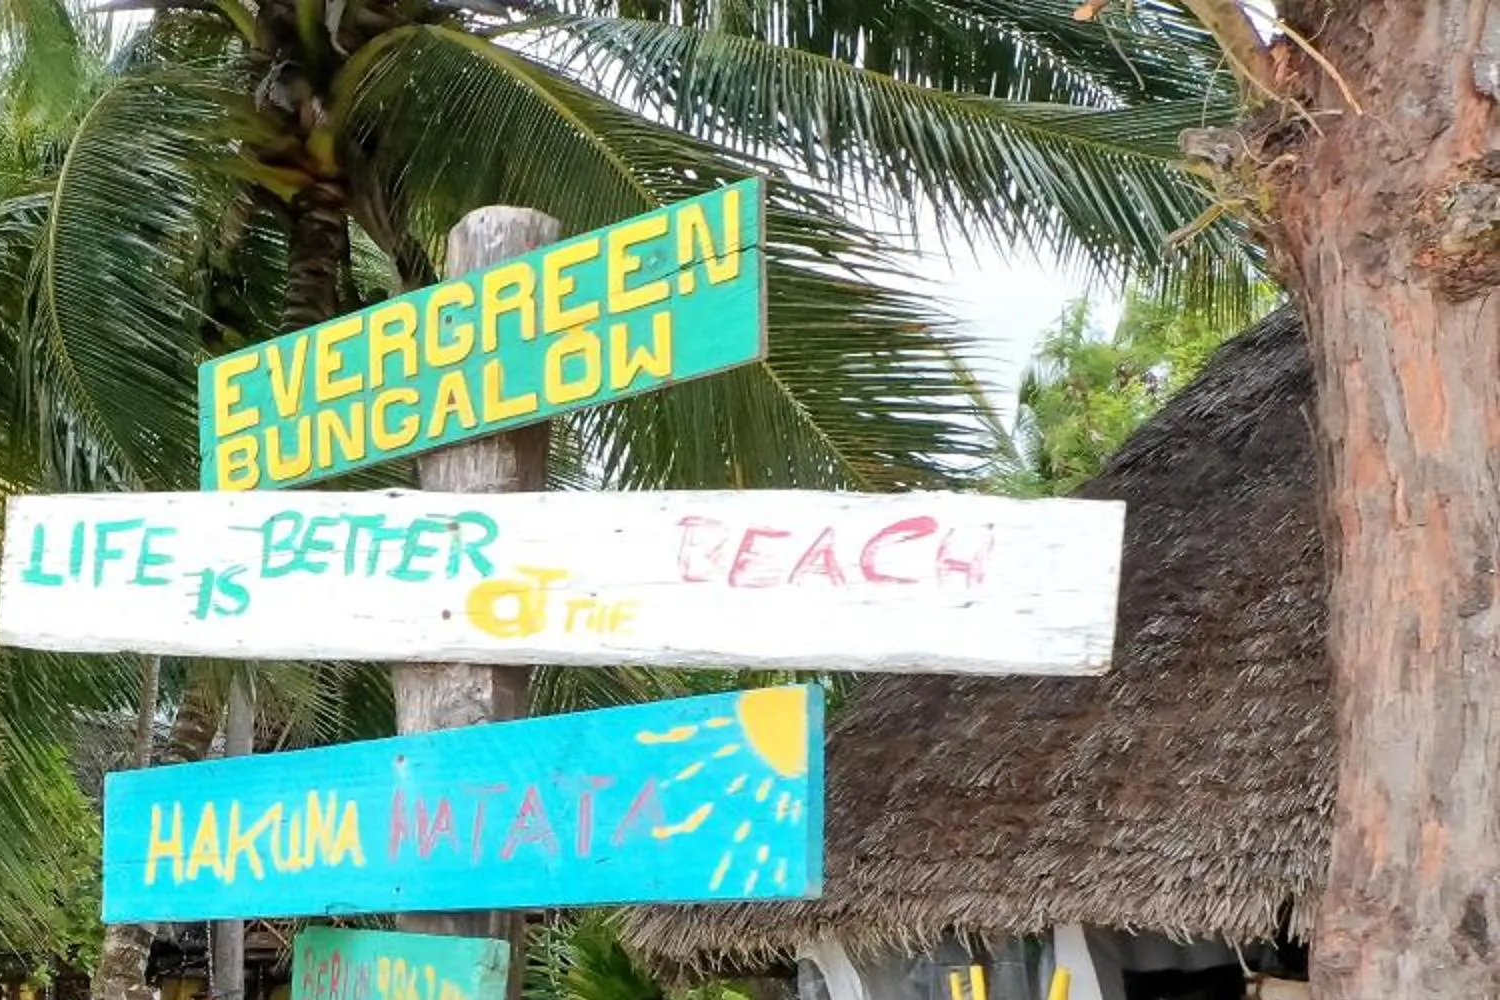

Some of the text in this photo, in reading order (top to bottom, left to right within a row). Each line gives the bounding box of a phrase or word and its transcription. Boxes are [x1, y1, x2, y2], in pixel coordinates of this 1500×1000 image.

[214, 190, 742, 438] EVERGREEN
[216, 311, 673, 491] BUNGALOW
[21, 519, 178, 587] LIFE
[191, 565, 249, 620] IS
[261, 511, 498, 580] BETTER
[676, 515, 994, 588] BEACH
[144, 790, 366, 885] HAKUNA
